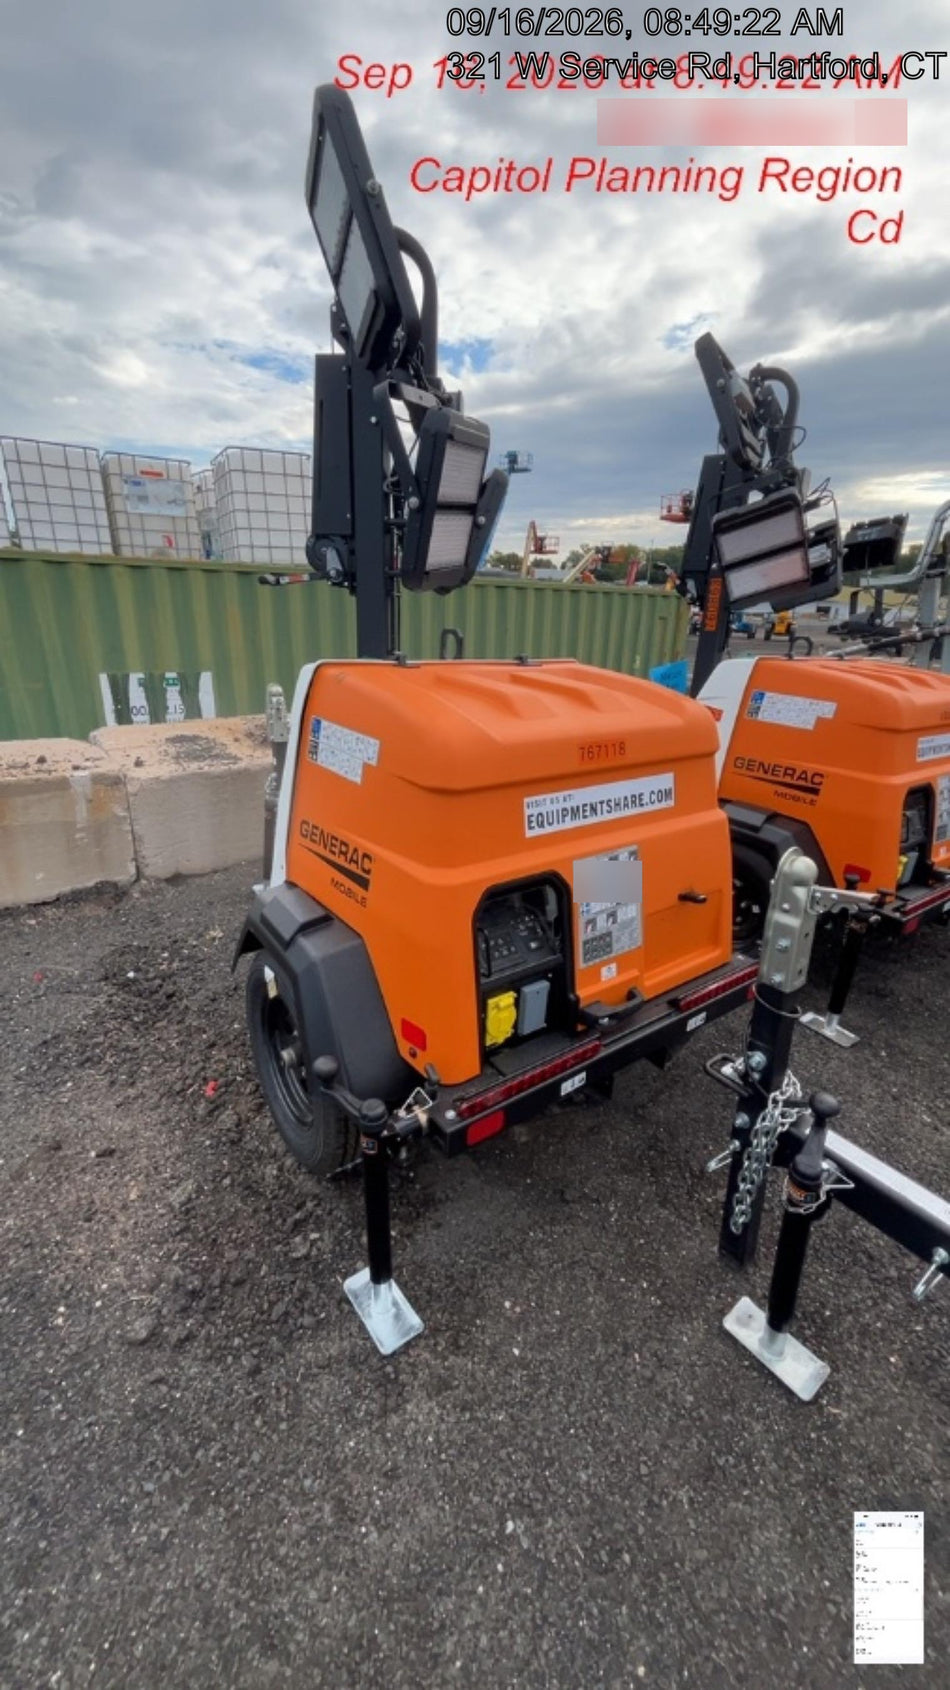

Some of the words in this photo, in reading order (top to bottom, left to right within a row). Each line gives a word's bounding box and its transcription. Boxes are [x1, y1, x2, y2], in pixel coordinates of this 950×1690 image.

[578, 741, 627, 762] 767118
[734, 756, 825, 786] GENERAC
[527, 786, 673, 831] EQUIPMENTSHARE.COM
[773, 790, 818, 806] MOBILE
[300, 819, 374, 876] GENERAC
[330, 877, 368, 908] MOBILE
